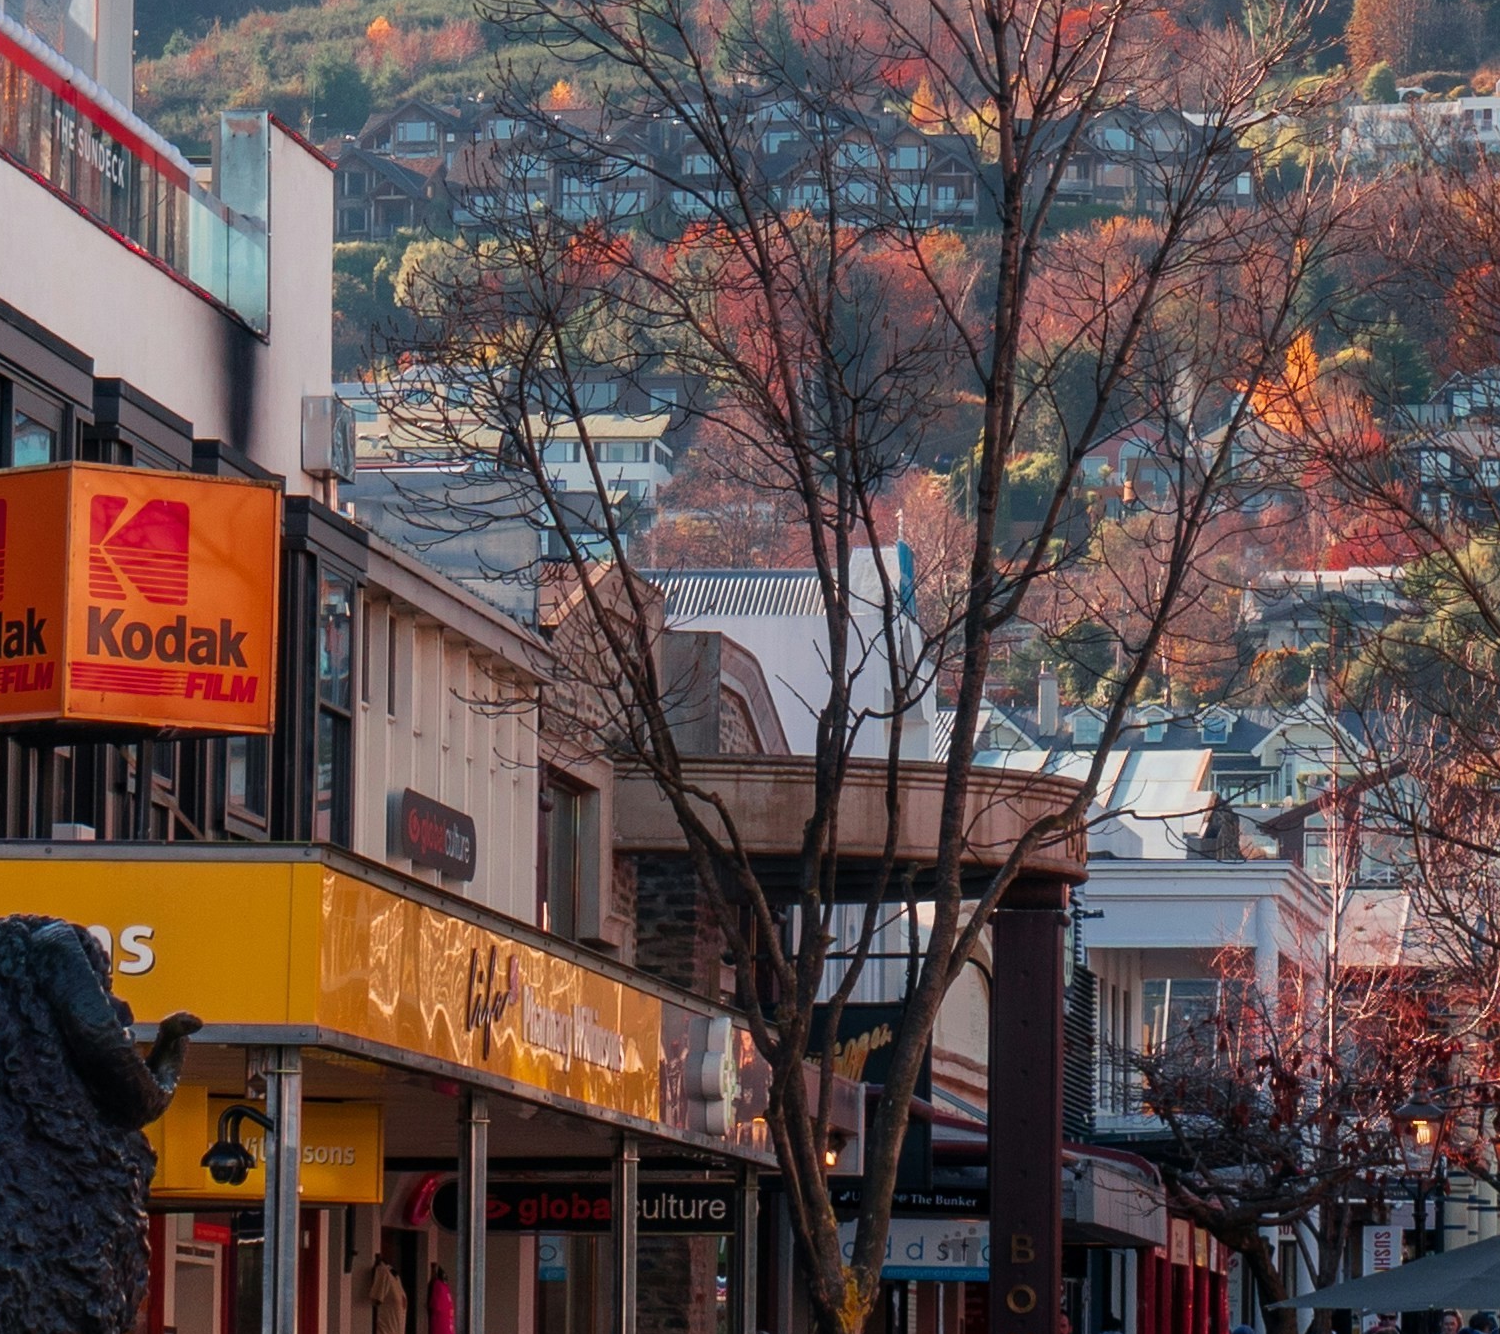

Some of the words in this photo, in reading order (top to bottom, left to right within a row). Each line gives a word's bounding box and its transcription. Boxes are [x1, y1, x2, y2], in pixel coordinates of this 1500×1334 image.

[55, 109, 74, 151] THE
[78, 128, 124, 189] SUNDECK
[87, 605, 249, 668] Kodak
[0, 662, 55, 694] FILM
[184, 672, 259, 704] FILM
[244, 1136, 356, 1166] ilsons
[518, 1192, 612, 1226] globa
[910, 1193, 933, 1206] The
[935, 1194, 978, 1208] Bunker
[1373, 1231, 1391, 1271] SUSHI
[952, 1269, 990, 1279] agenc
